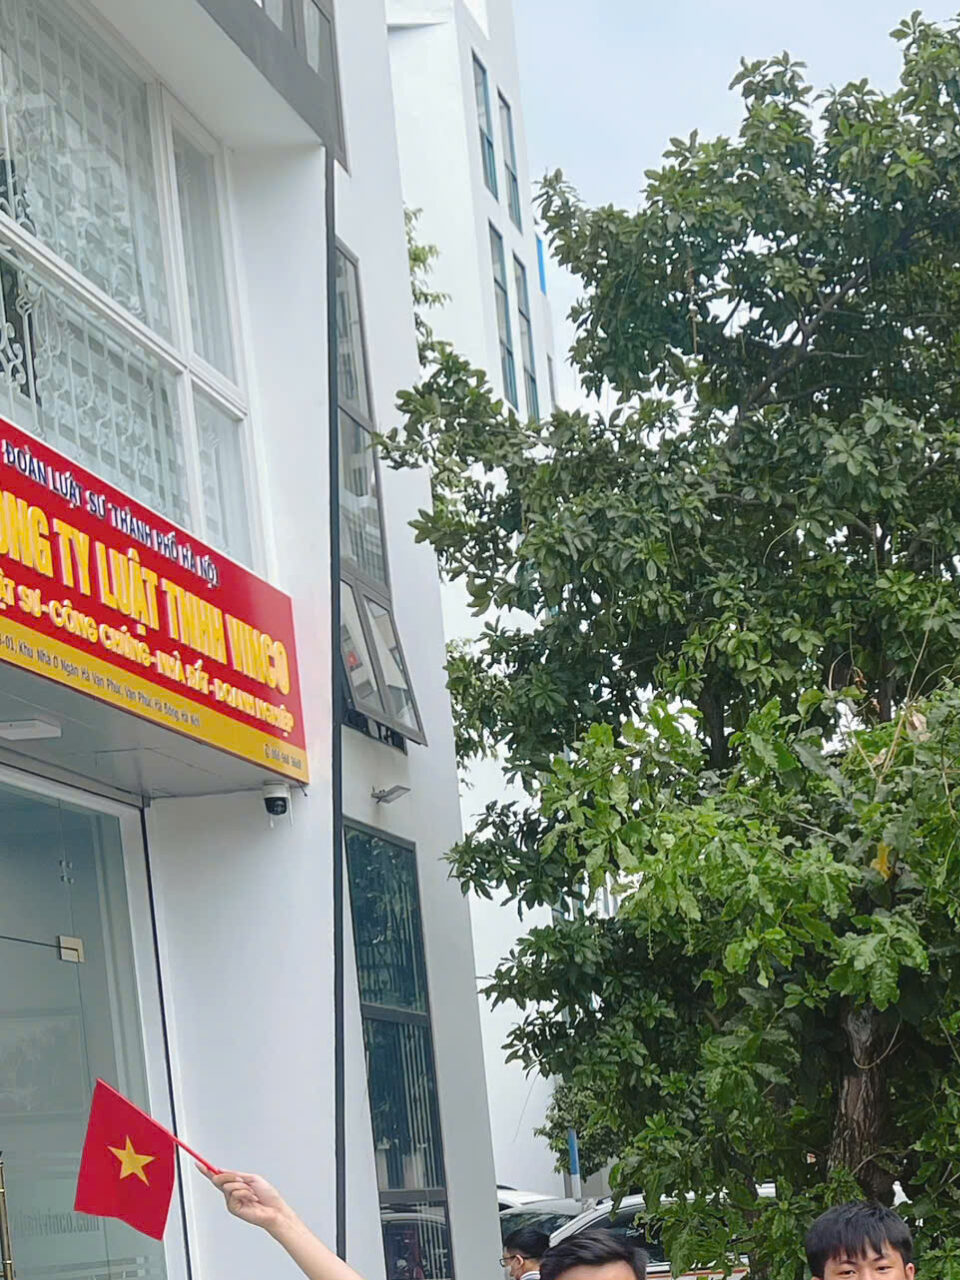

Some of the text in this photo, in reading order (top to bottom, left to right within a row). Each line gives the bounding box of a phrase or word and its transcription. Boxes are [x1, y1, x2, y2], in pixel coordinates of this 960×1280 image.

[2, 439, 47, 487] ĐOÀN
[107, 502, 153, 549] THÀNH
[152, 530, 179, 563] PHỐ
[178, 542, 197, 574] HÀ
[195, 554, 219, 589] NỘI
[52, 518, 91, 596] TY
[95, 540, 160, 636] LUẬT
[161, 577, 227, 665] TNHH
